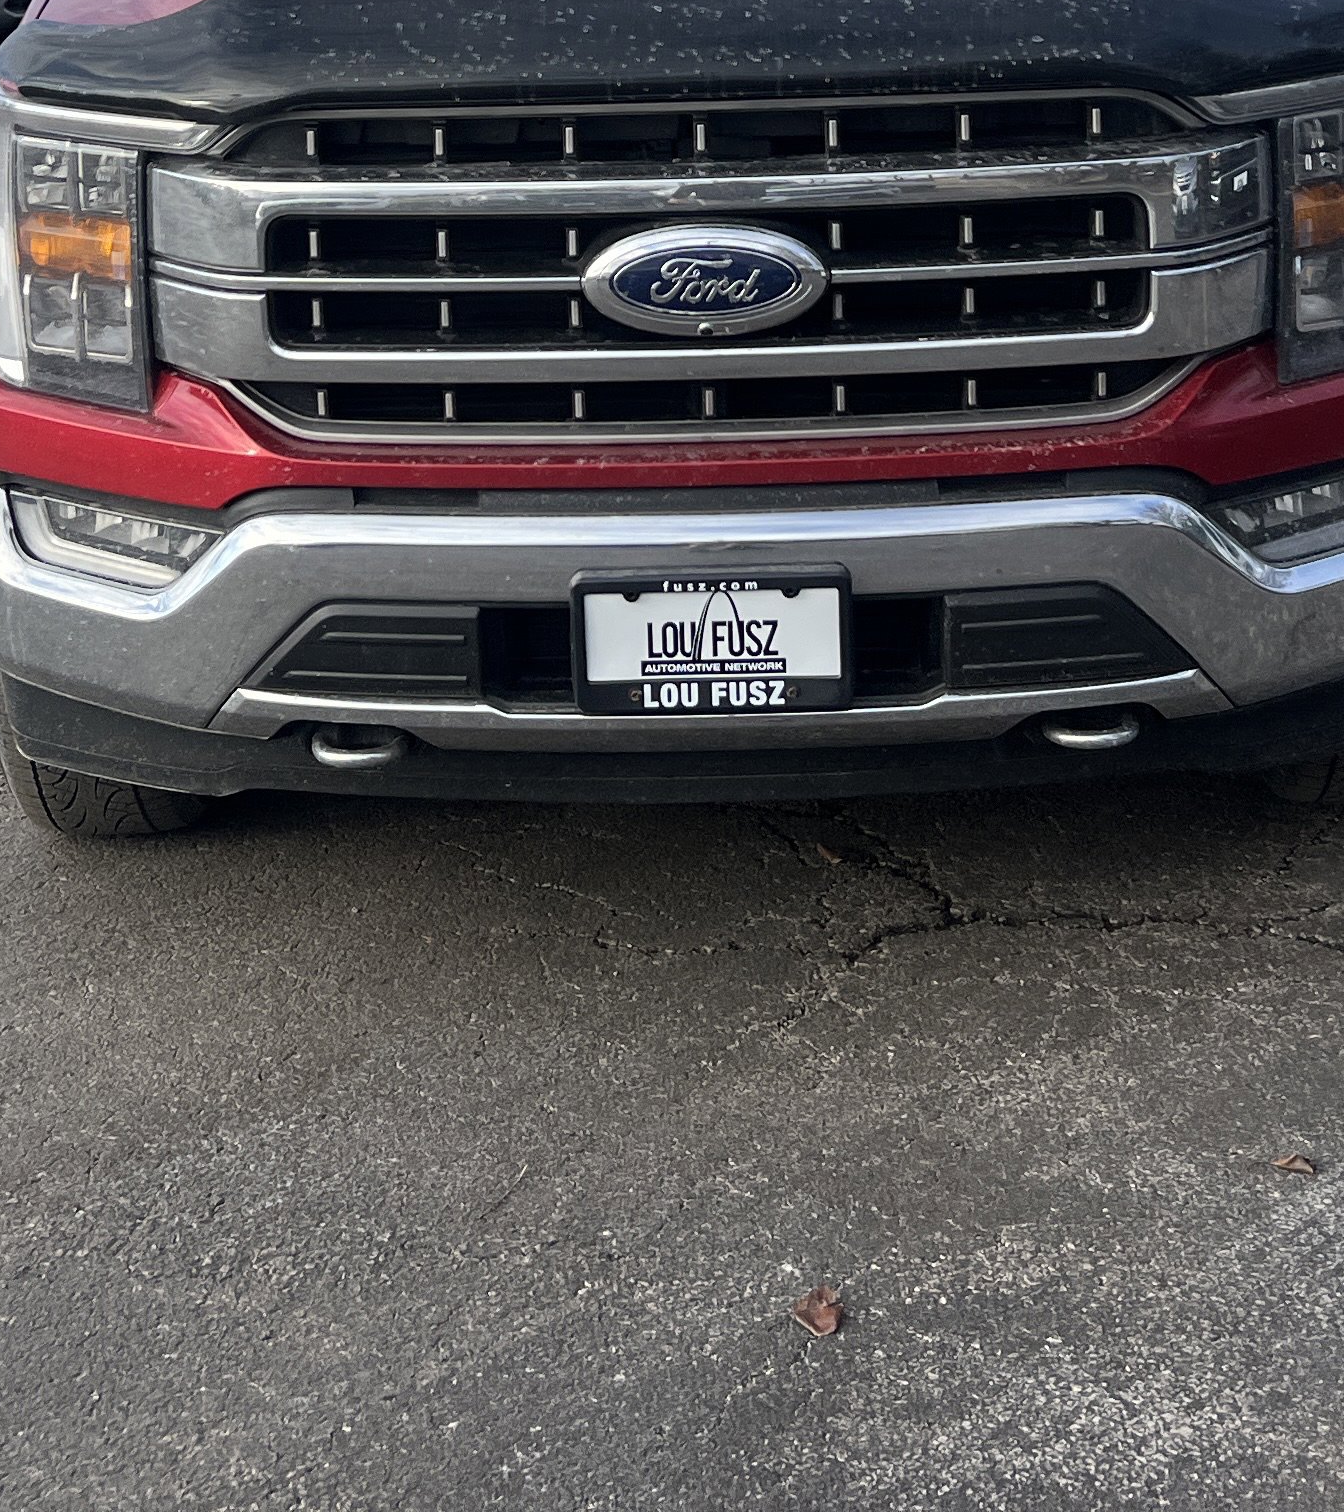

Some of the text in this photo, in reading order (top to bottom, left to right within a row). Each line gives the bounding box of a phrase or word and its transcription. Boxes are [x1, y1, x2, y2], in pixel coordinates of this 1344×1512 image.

[650, 257, 761, 304] Ford
[662, 580, 758, 593] fusz.com
[646, 619, 779, 659] LOU FUSZ
[644, 660, 784, 673] AUTOMOTIVE NETWORK
[643, 680, 786, 708] LOU FUSZ
